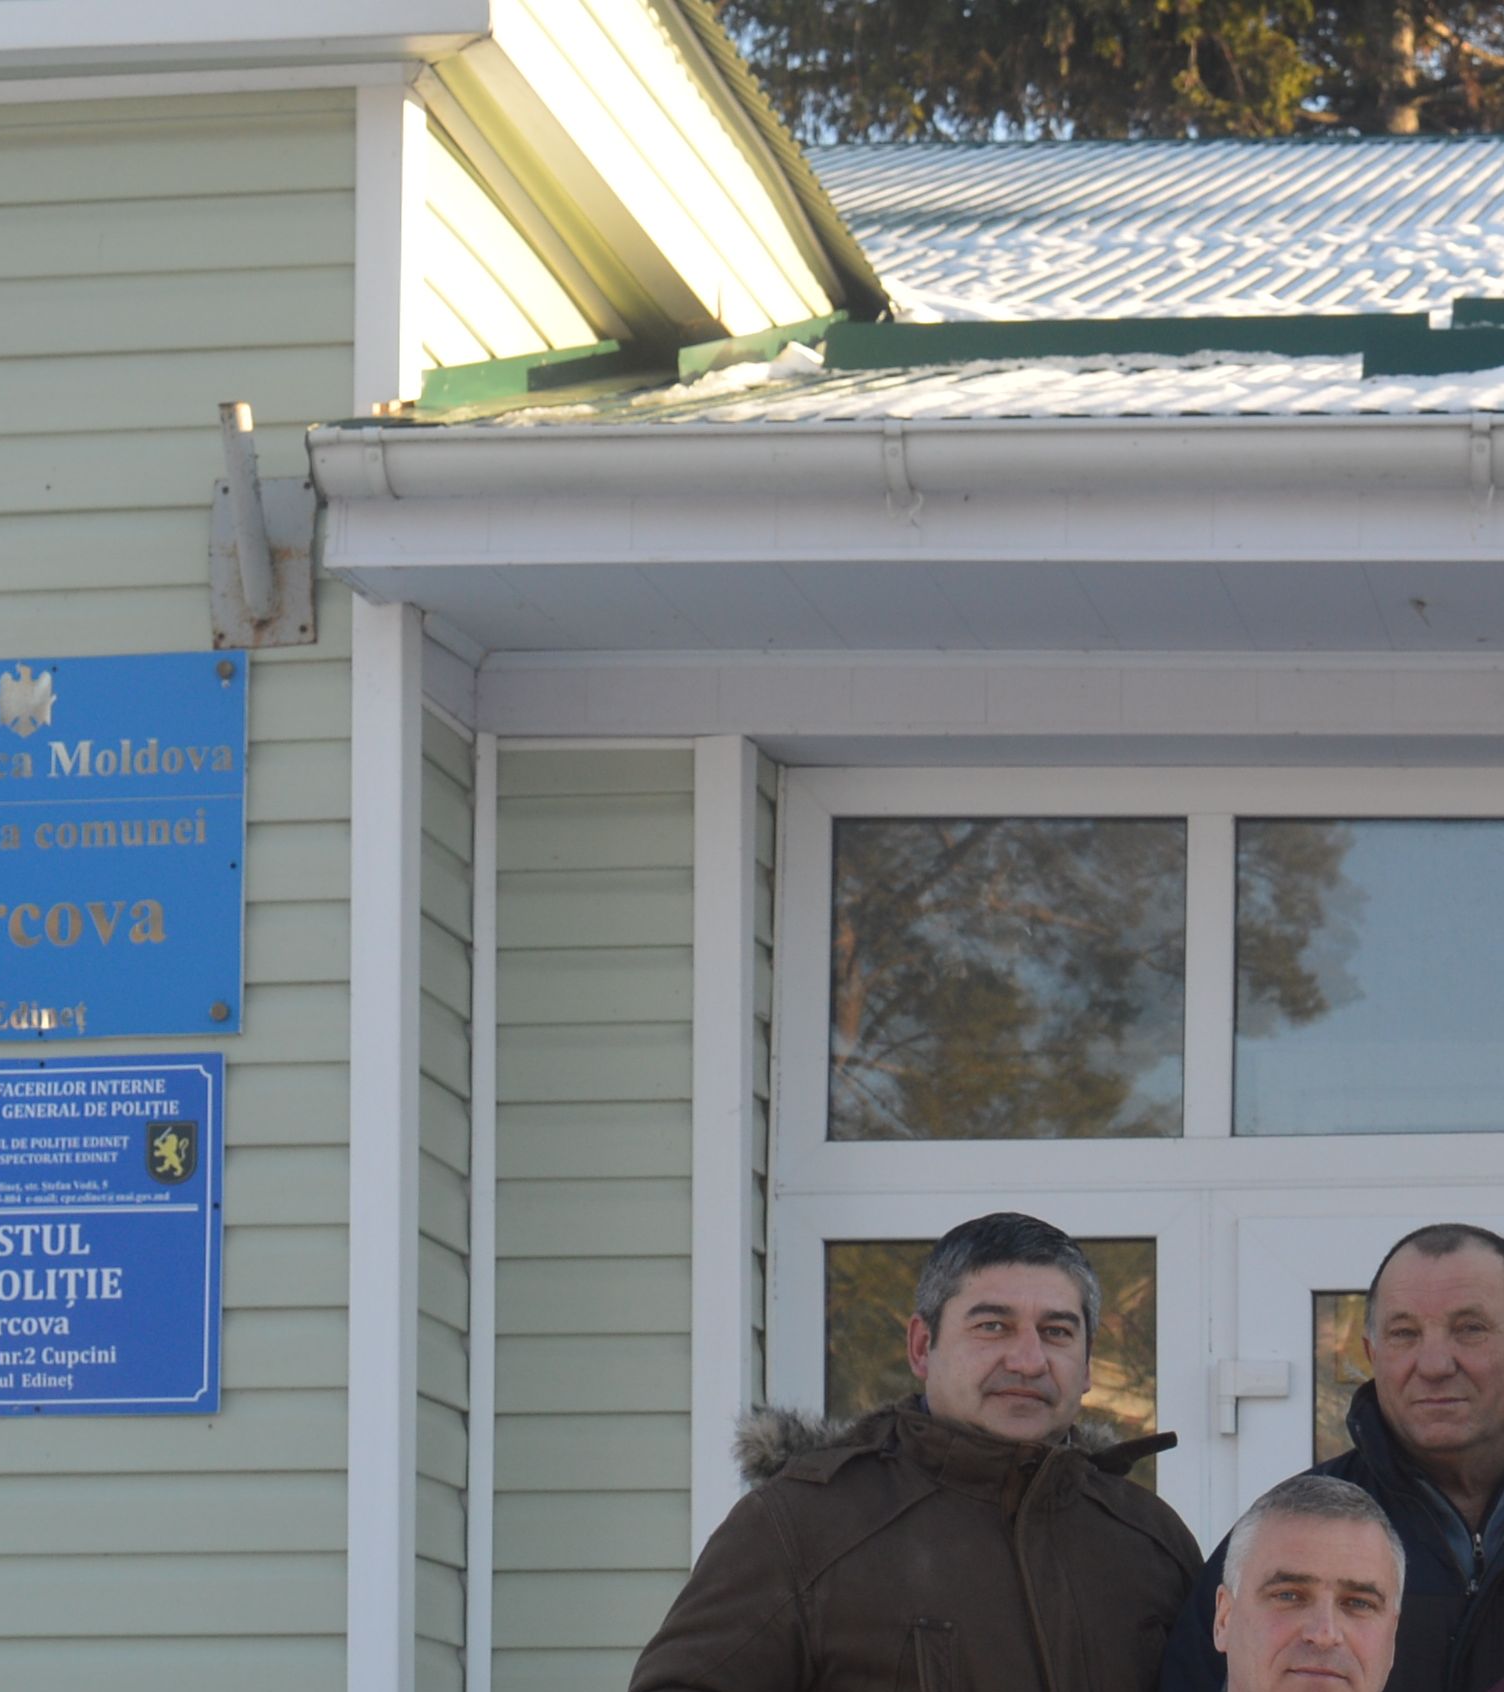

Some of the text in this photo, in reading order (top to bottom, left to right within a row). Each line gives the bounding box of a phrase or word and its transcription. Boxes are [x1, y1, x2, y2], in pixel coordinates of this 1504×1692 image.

[47, 738, 233, 778] Moldova
[35, 808, 207, 849] comunei
[91, 1078, 166, 1095] INTERNE
[2, 1102, 80, 1119] GENERAL
[84, 1102, 108, 1117] DE
[11, 1137, 27, 1150] DE
[41, 1345, 116, 1368] Cupcini
[21, 1371, 74, 1391] Edineț
